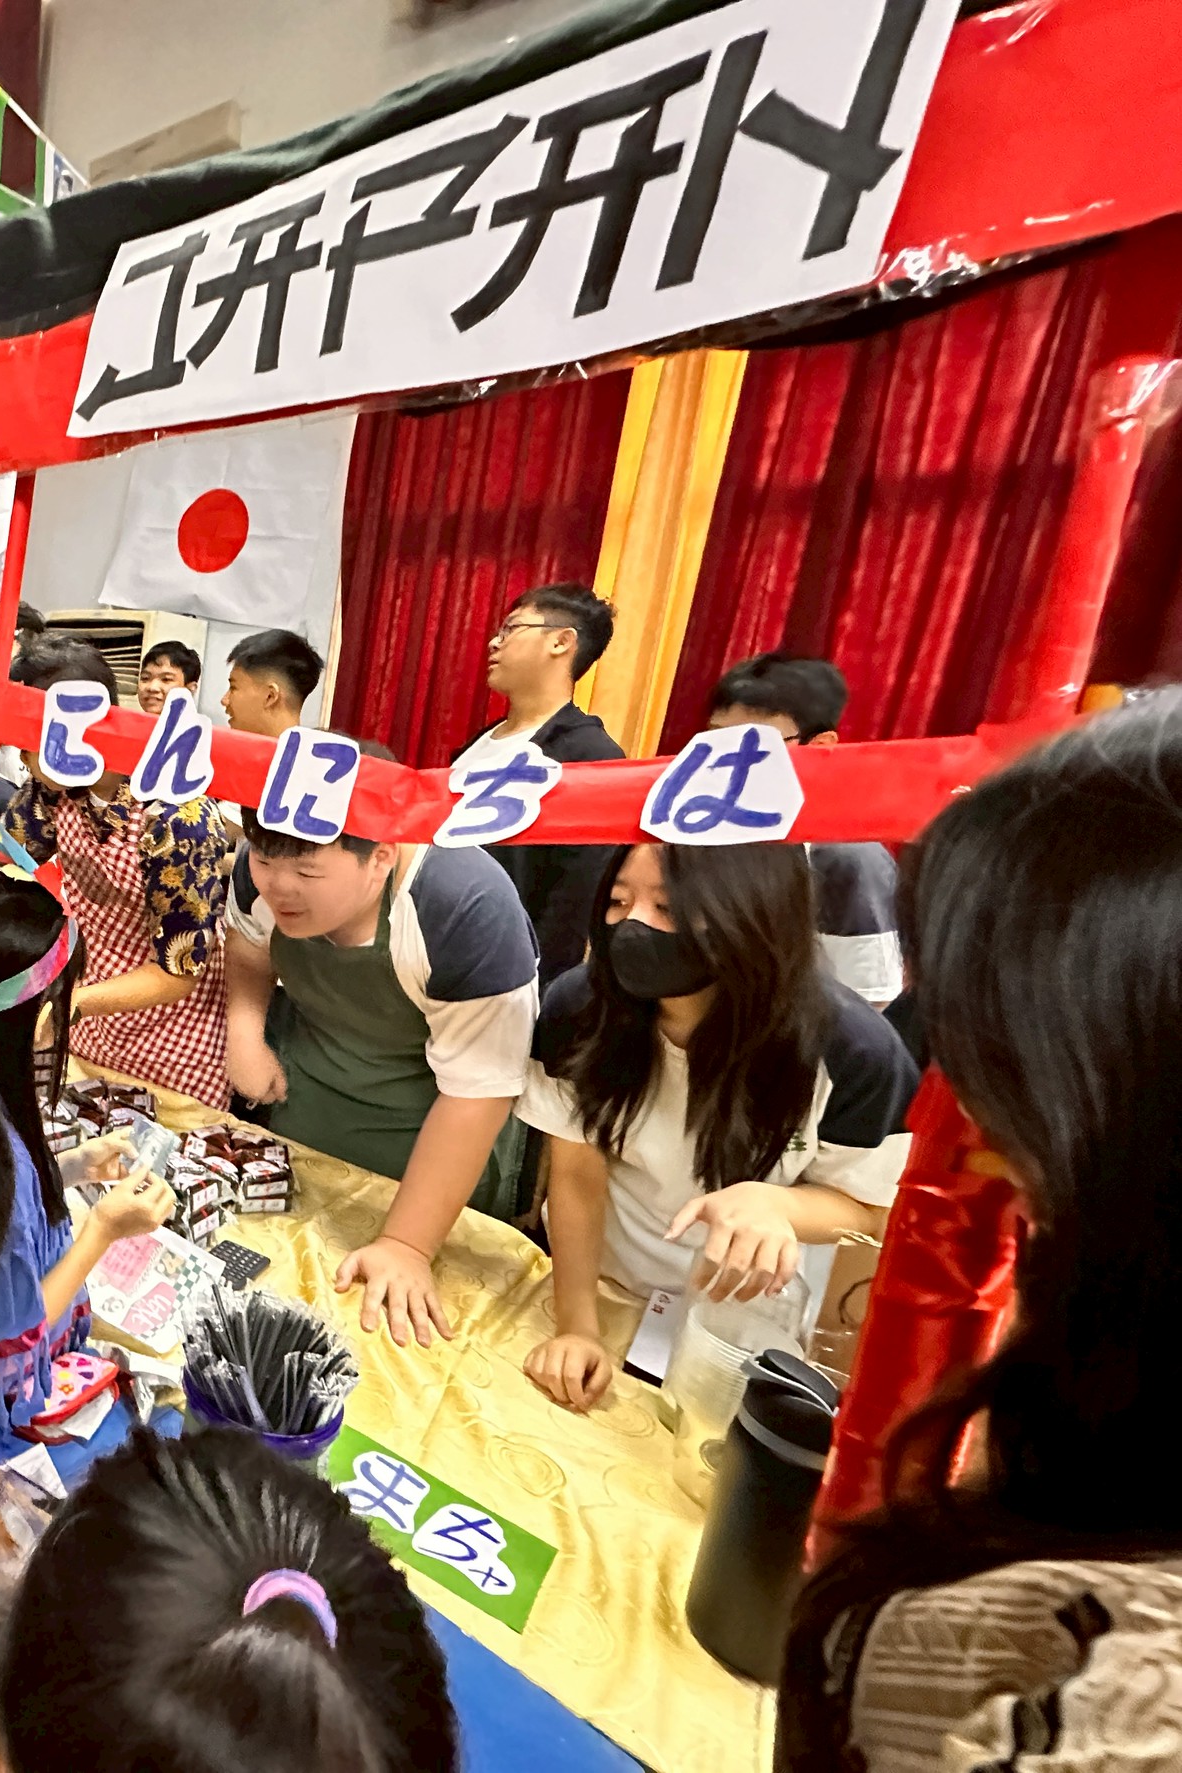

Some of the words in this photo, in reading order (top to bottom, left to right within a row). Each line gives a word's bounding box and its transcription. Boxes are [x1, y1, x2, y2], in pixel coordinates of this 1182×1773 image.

[76, 0, 926, 422] JAPAN
[44, 693, 783, 837] こんにちは
